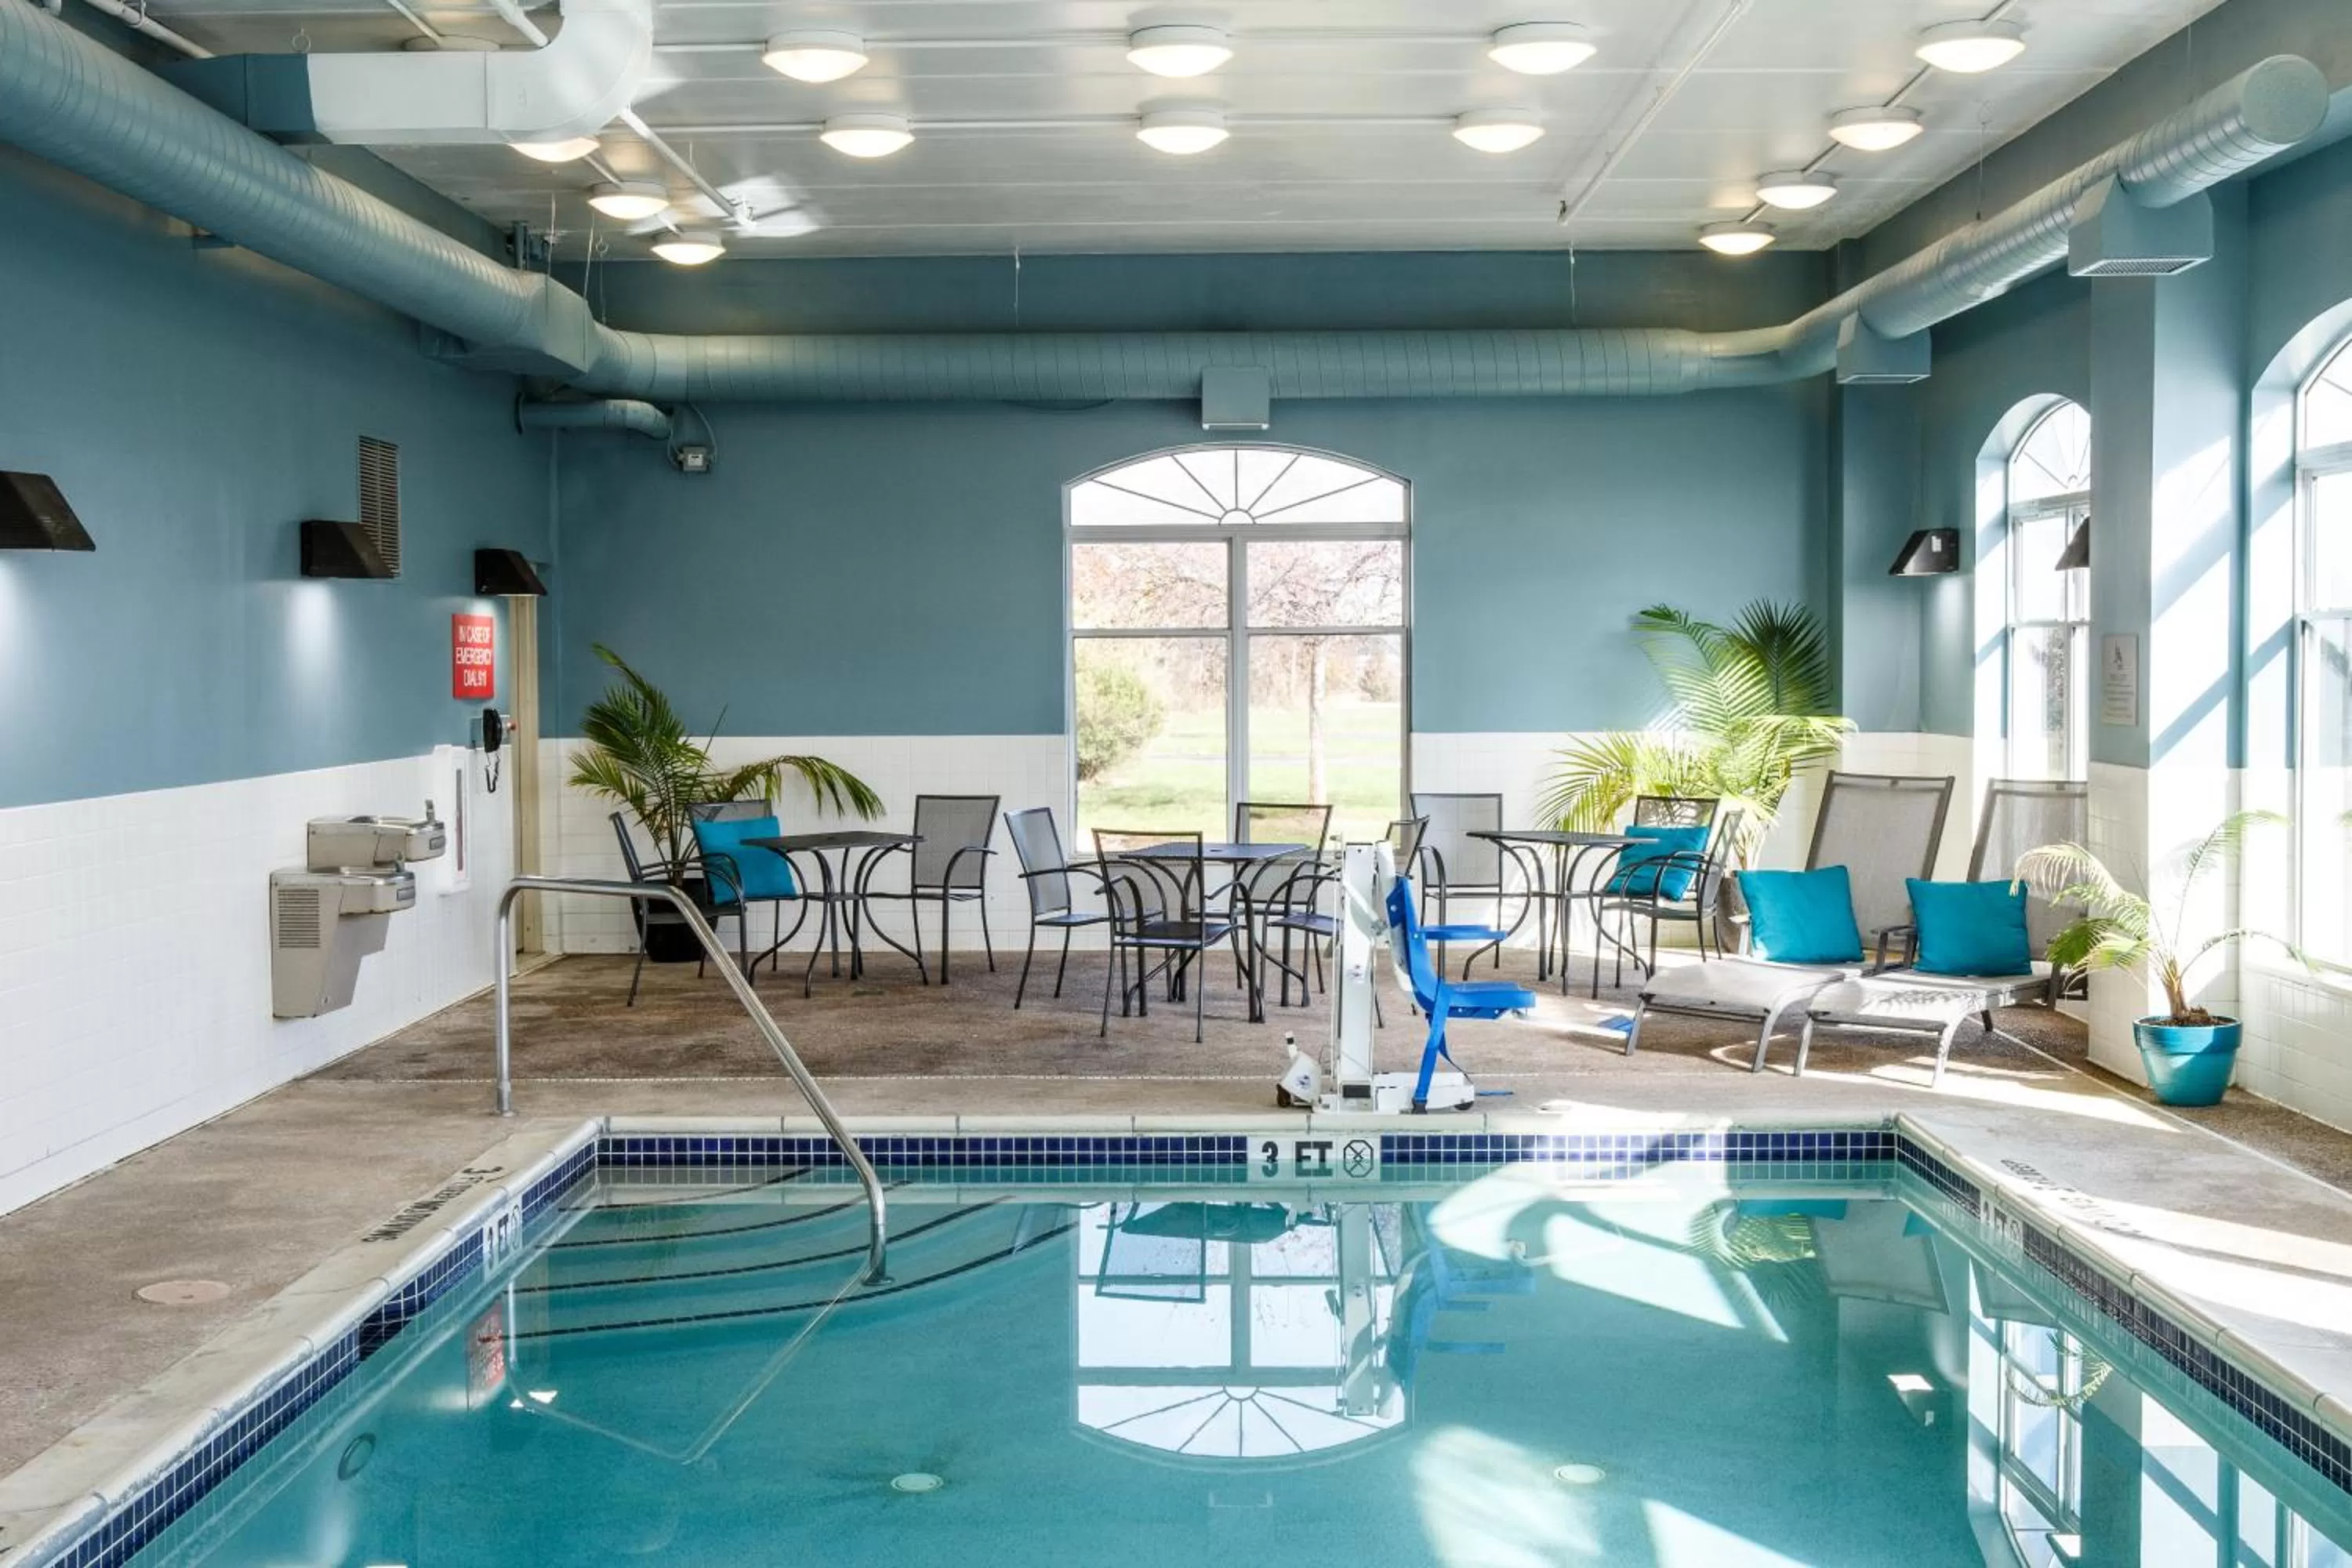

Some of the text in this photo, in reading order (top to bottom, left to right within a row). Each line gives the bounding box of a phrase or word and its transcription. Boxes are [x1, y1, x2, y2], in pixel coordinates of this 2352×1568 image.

[466, 626, 482, 643] CASE
[482, 626, 490, 643] OF
[456, 648, 492, 665] EMERGENCY
[463, 669, 478, 687] DIAL
[1261, 1141, 1279, 1165] 3
